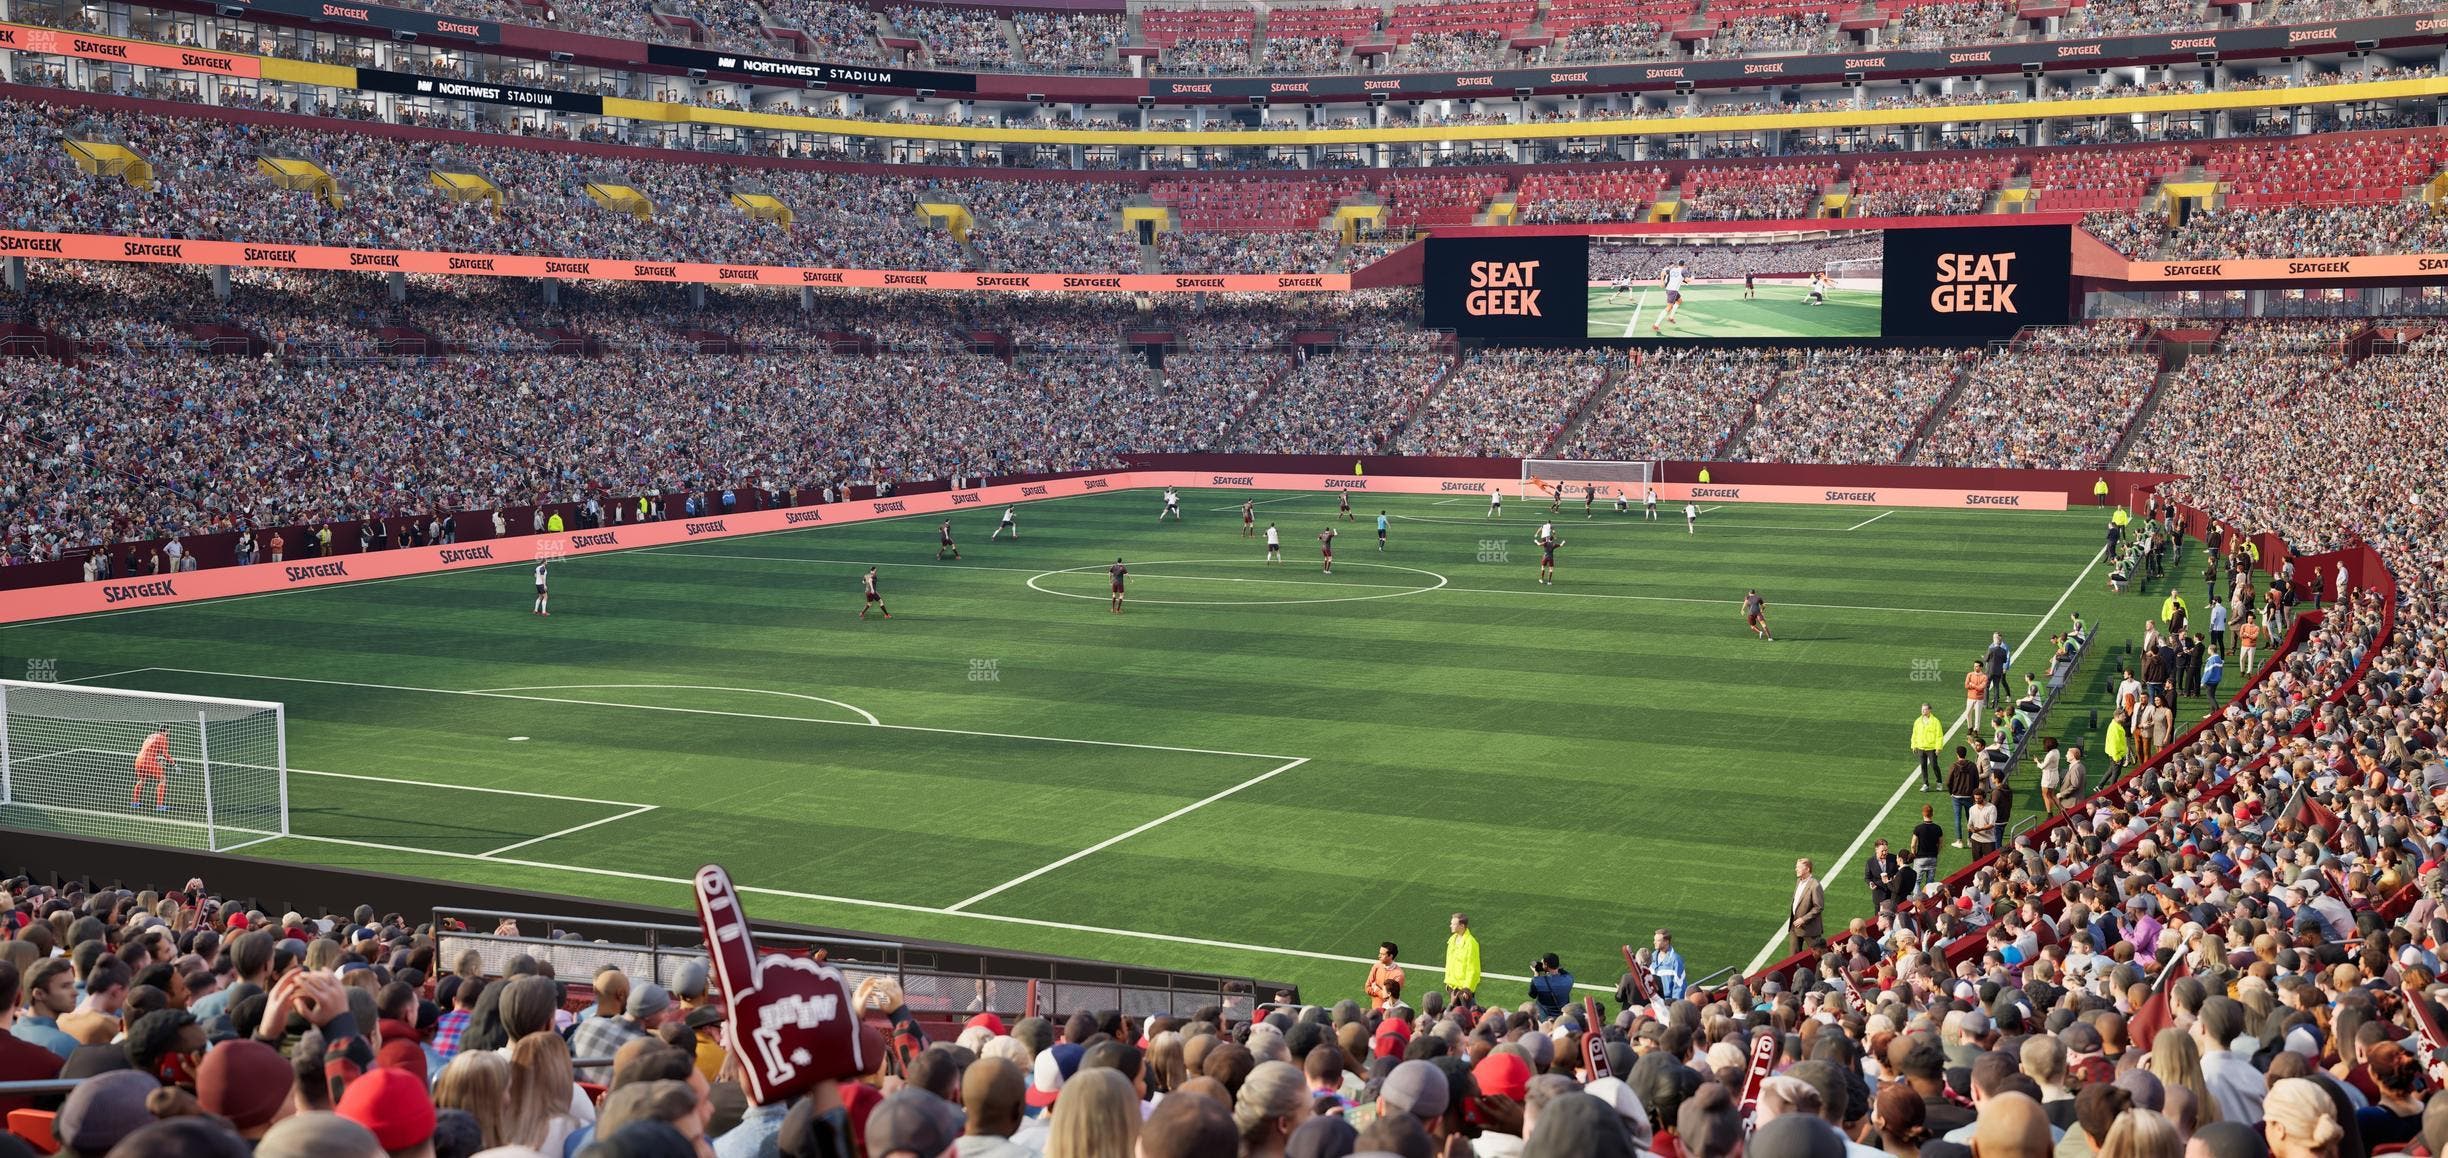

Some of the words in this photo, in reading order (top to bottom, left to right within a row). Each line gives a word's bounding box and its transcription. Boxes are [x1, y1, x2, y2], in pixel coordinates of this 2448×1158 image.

[323, 4, 368, 21] SEATGEEK
[437, 20, 479, 36] SEATGEEK
[2416, 19, 2448, 31] SEATG
[2289, 28, 2336, 42] SEATGEEK
[74, 40, 127, 58] SEATGEEK
[2171, 37, 2216, 50] SEATGEEK
[2058, 44, 2101, 57] SEATGEEK
[182, 53, 232, 71] SEATGEEK
[1950, 51, 1990, 63] SEATGEEK
[1745, 63, 1783, 73] SEATGEEK
[1845, 57, 1885, 70] SEATGEEK
[744, 60, 820, 77] NORTHWEST
[831, 69, 890, 82] STADIUM
[1551, 72, 1588, 82] SEATGEEK
[1647, 68, 1684, 79] SEATGEEK
[1365, 80, 1400, 89] SEATGEEK
[1457, 76, 1493, 86] SEATGEEK
[439, 82, 500, 99] NORTHWEST
[508, 91, 552, 104] STADIUM
[1172, 84, 1211, 93] SEATGEEK
[1271, 83, 1308, 92] SEATGEEK
[1, 236, 62, 253] SEATGEEK
[124, 242, 182, 258] SEATGEEK
[245, 248, 296, 263] SEATGEEK
[350, 253, 399, 267] SEATGEEK
[449, 258, 494, 270] SEATGEEK
[545, 262, 589, 274] SEATGEEK
[1937, 252, 2016, 282] SEAT
[2289, 262, 2349, 274] SEATGEEK
[2419, 259, 2448, 270] SEAT
[634, 265, 676, 277] SEATGEEK
[720, 269, 758, 280] SEATGEEK
[1471, 261, 1539, 287] SEAT
[2164, 265, 2221, 276] SEATGEEK
[804, 272, 842, 282] SEATGEEK
[885, 274, 927, 285] SEATGEEK
[977, 277, 1029, 286] SEATGEEK
[1064, 278, 1120, 287] SEATGEEK
[1177, 279, 1224, 287] SEATGEEK
[1279, 278, 1322, 287] SEATGEEK
[1466, 290, 1541, 316] GEEK
[1931, 284, 2017, 313] GEEK
[1084, 479, 1108, 489] SEATGEEK
[1213, 476, 1253, 485] SEATGEEK
[1325, 479, 1366, 488] SEATGEEK
[1442, 482, 1485, 491] SEATGEEK
[1022, 486, 1048, 496] SEATGEEK
[1692, 488, 1739, 498] SEATGEEK
[1826, 491, 1875, 502] SEATGEEK
[952, 493, 981, 505] SEATGEEK
[1966, 495, 2019, 505] SEATGEEK
[874, 501, 905, 513] SEATGEEK
[786, 510, 822, 524] SEATGEEK
[686, 520, 727, 536] SEATGEEK
[572, 532, 618, 549] SEATGEEK
[440, 546, 493, 564] SEATGEEK
[285, 561, 348, 582] SEATGEEK
[103, 580, 177, 603] SEATGEEK
